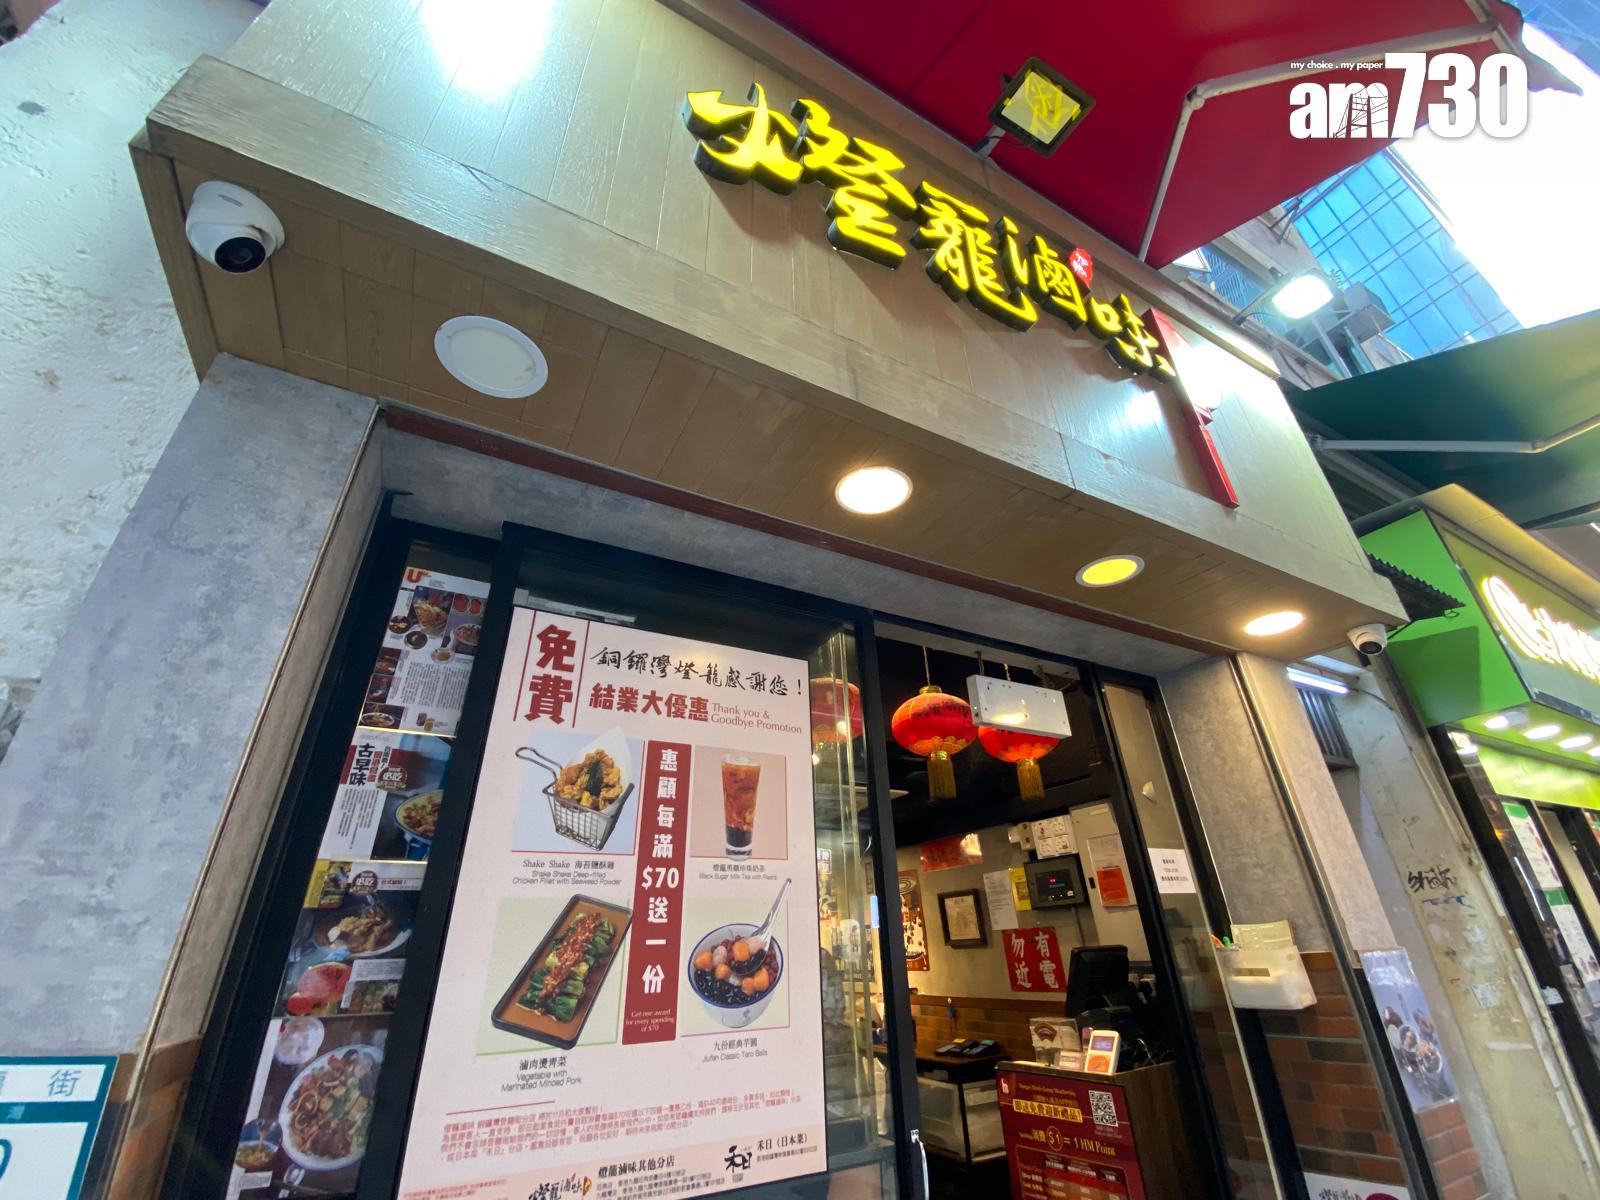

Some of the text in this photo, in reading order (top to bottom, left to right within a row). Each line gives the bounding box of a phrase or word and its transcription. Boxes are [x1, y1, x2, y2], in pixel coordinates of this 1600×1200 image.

[524, 624, 577, 725] 免費
[588, 682, 710, 723] 結業大優惠
[712, 702, 770, 720] Thank you &
[711, 714, 802, 734] Goodbye Promotion
[350, 743, 376, 787] 古早味
[522, 860, 545, 868] Shake
[549, 860, 570, 868] Shake
[1011, 933, 1032, 988] 勿近
